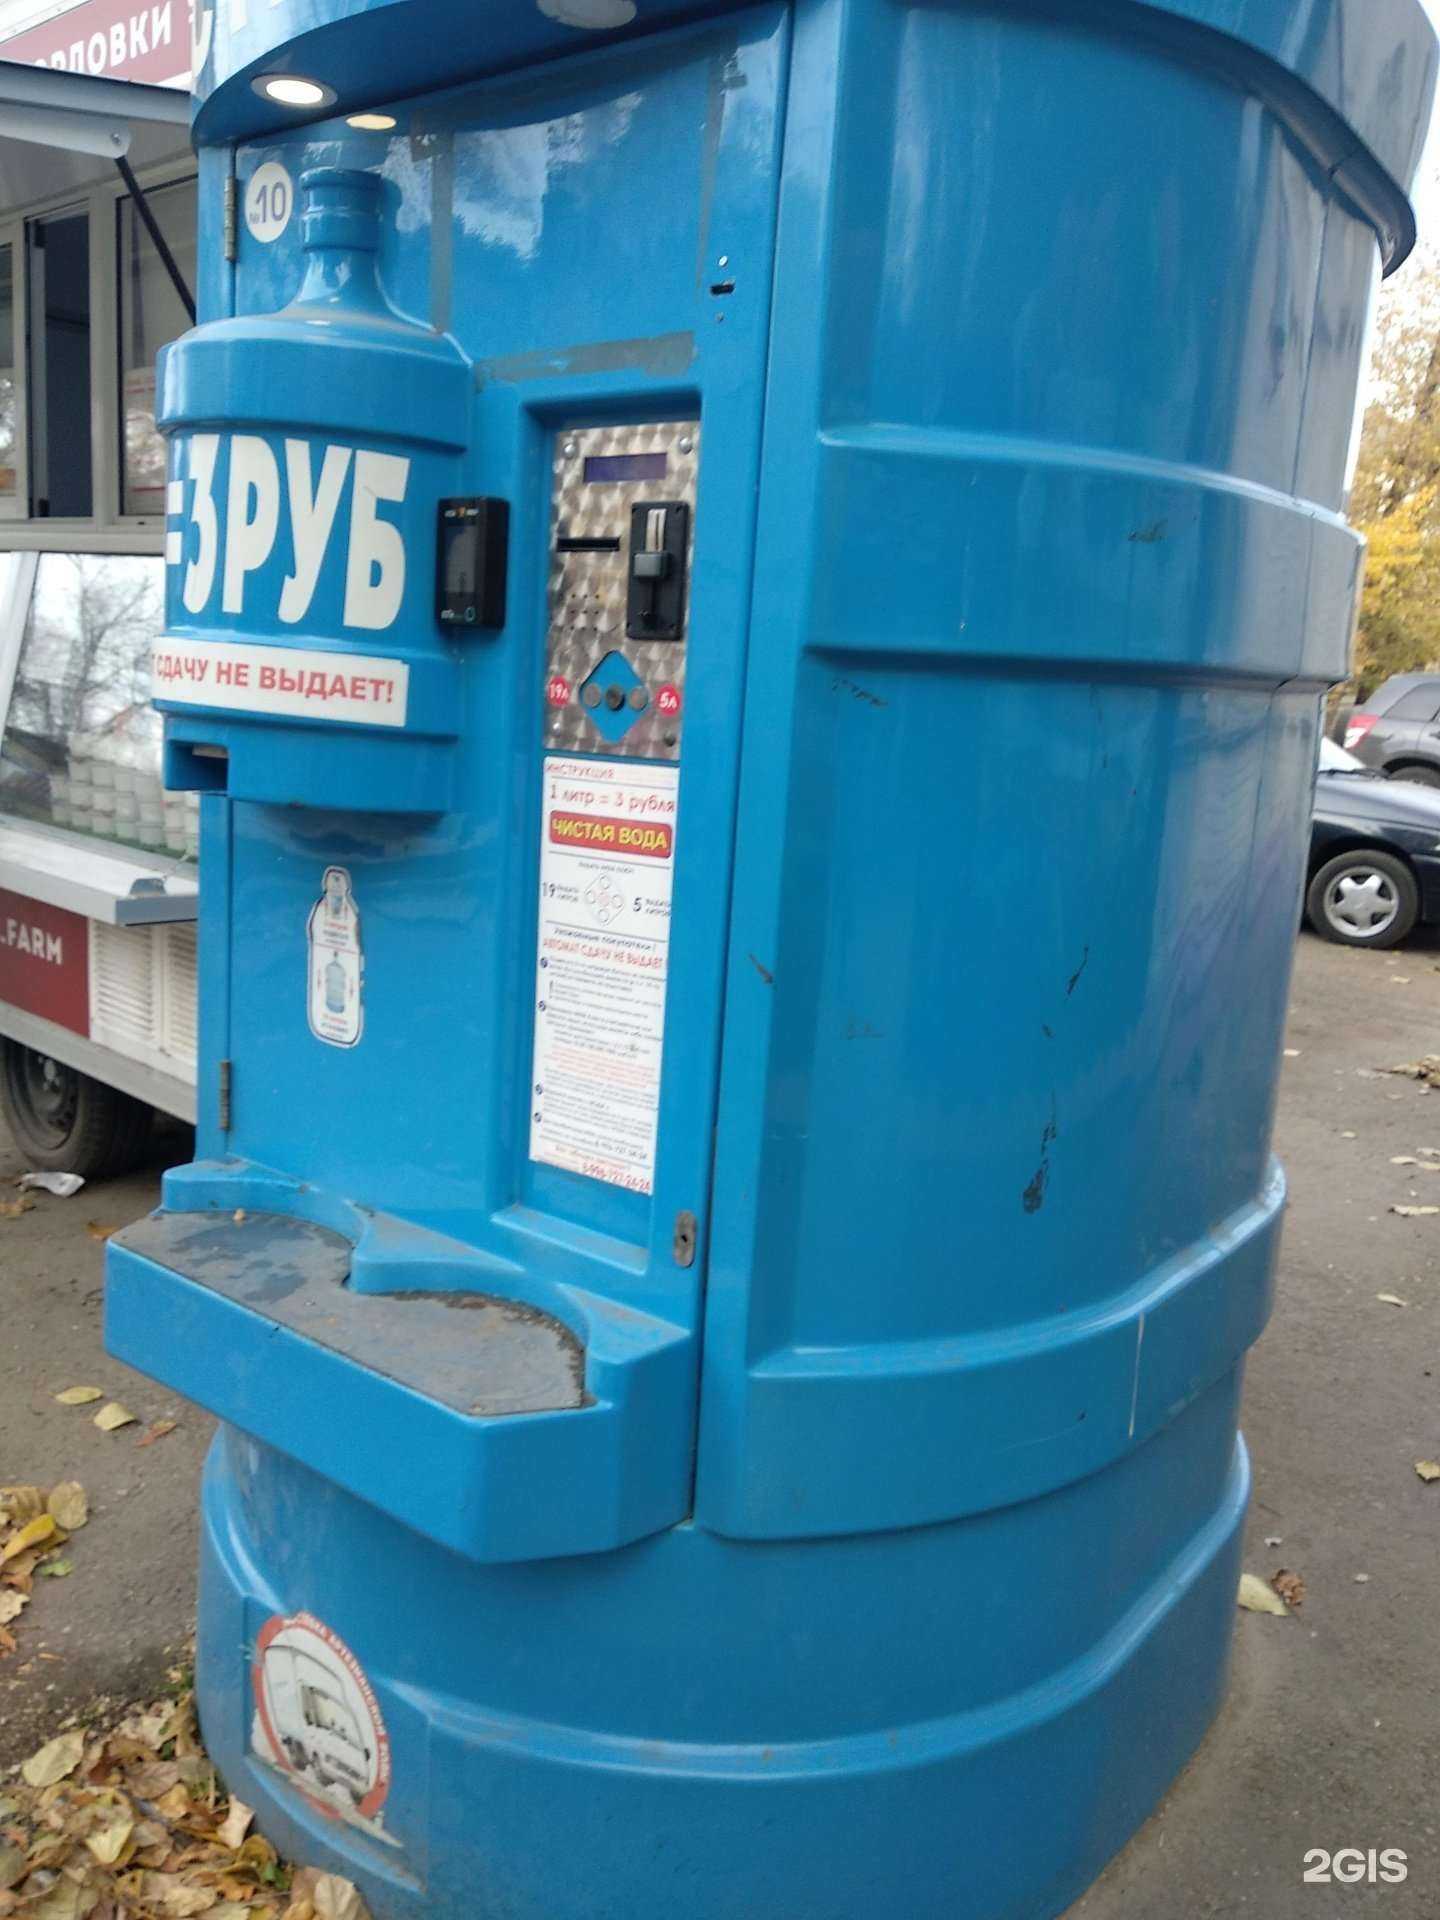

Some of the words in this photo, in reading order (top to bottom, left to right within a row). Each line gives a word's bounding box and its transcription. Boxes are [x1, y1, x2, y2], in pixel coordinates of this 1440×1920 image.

[156, 655, 209, 683] СДАЧУ
[216, 662, 249, 688] НЕ
[258, 669, 395, 704] ВЫДАЕТ!
[614, 791, 624, 807] 3
[629, 794, 675, 813] рубля
[551, 819, 616, 843] ЧИСТАЯ
[618, 826, 668, 850] ВОДА
[632, 896, 642, 913] 5
